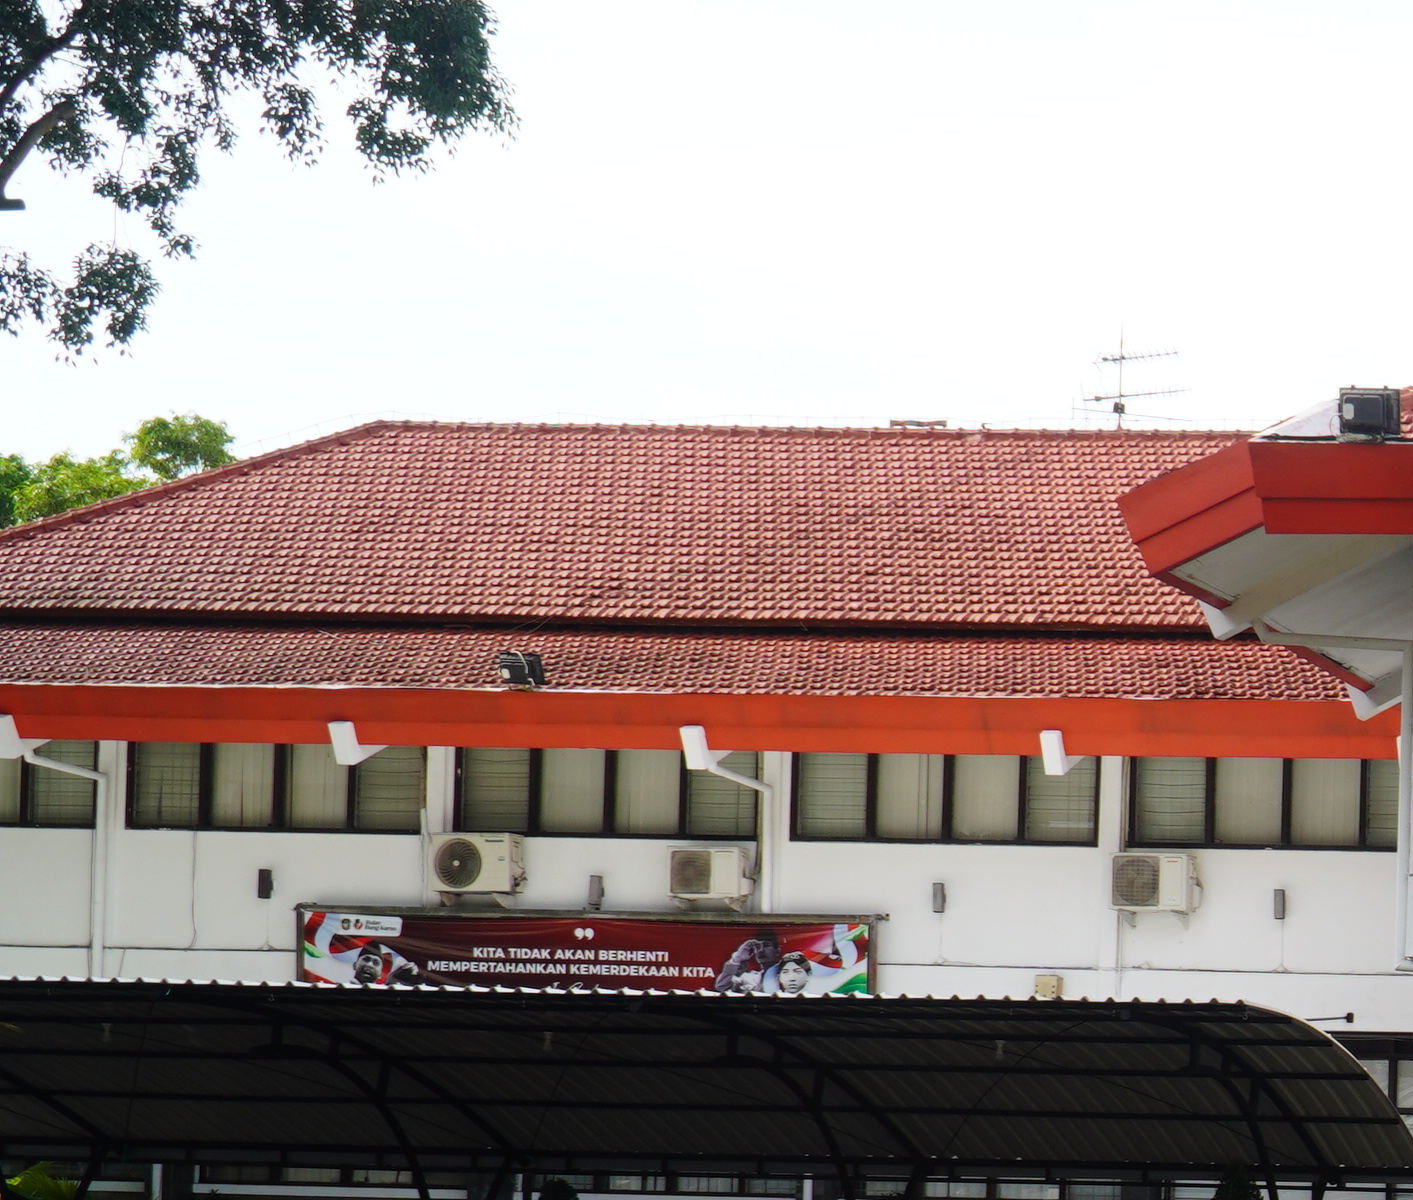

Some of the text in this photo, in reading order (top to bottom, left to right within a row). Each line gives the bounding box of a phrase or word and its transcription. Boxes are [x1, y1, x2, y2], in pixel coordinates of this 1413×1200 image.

[473, 947, 669, 962] KITA TIDAK AKAN BERHENTI
[427, 961, 715, 978] MEMPERTAHANKAN KEMERDEKAAN KITA
